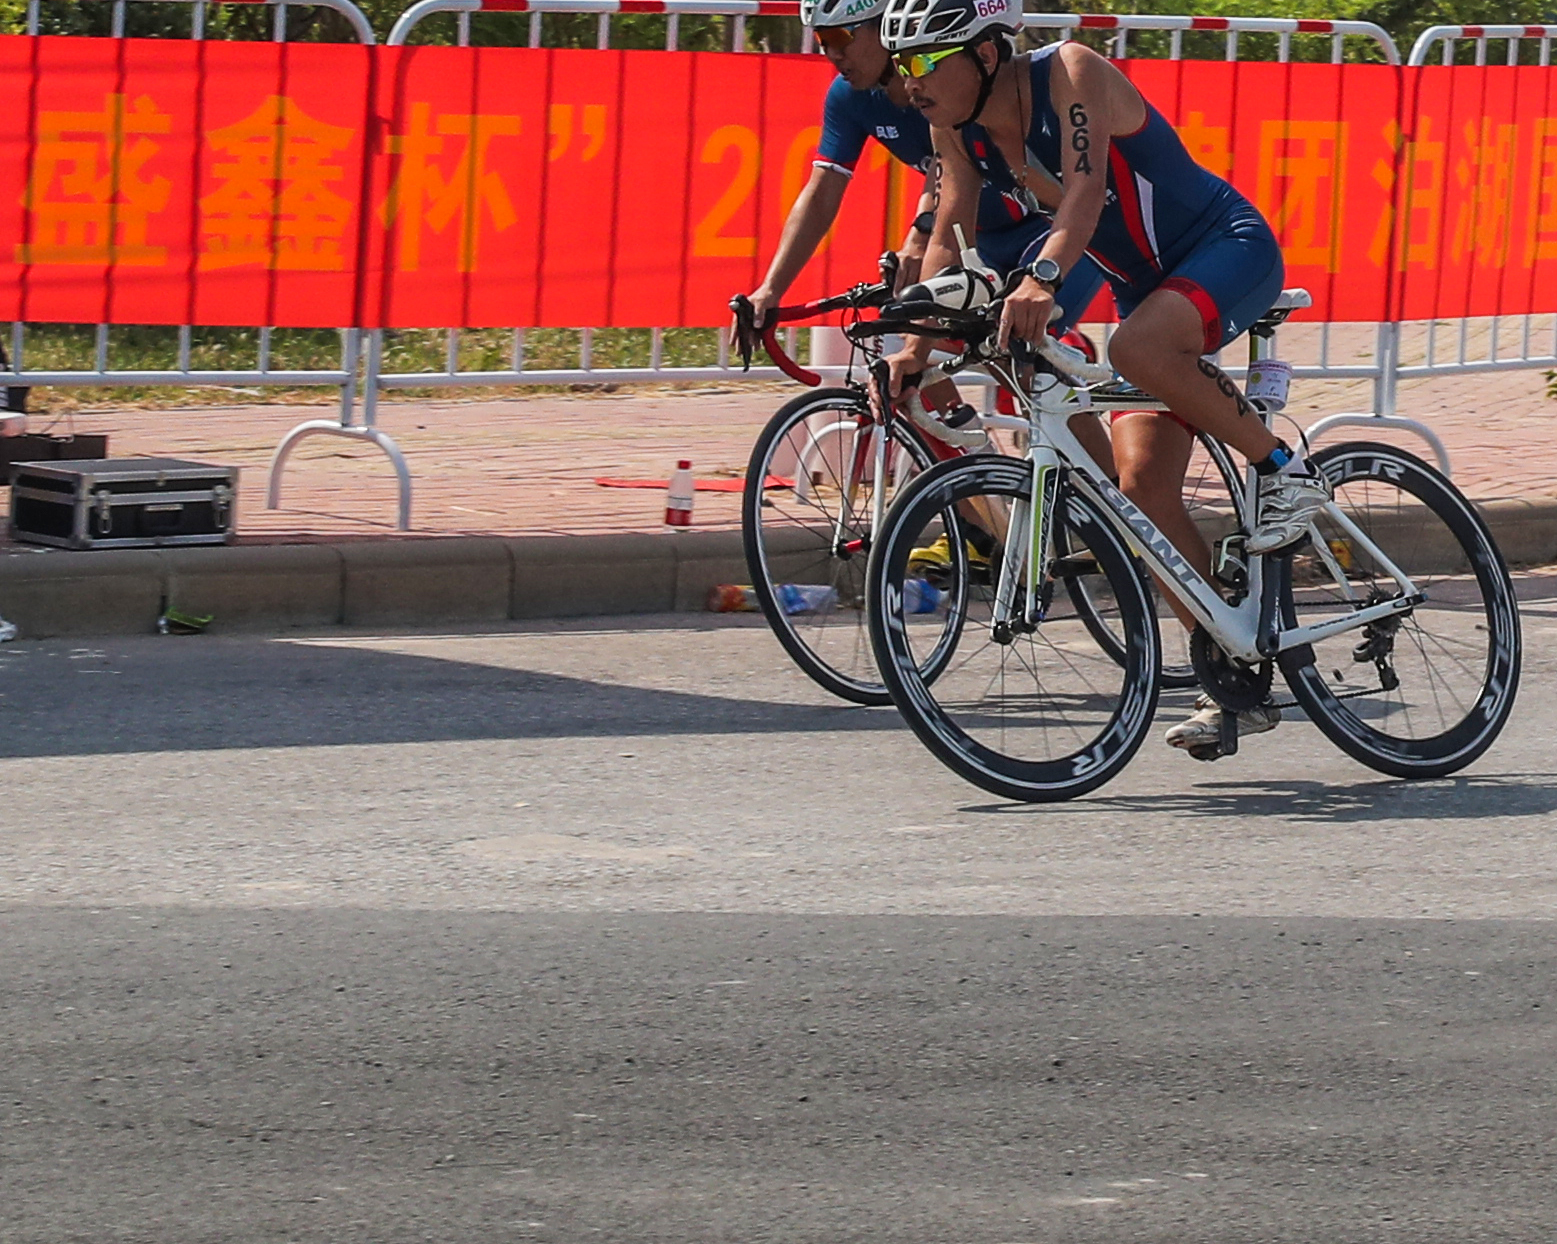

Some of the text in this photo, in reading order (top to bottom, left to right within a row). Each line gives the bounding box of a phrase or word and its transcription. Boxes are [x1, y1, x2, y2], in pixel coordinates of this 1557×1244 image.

[1069, 102, 1093, 176] 664
[1197, 356, 1251, 418] 664
[1099, 478, 1207, 590] GIANT
